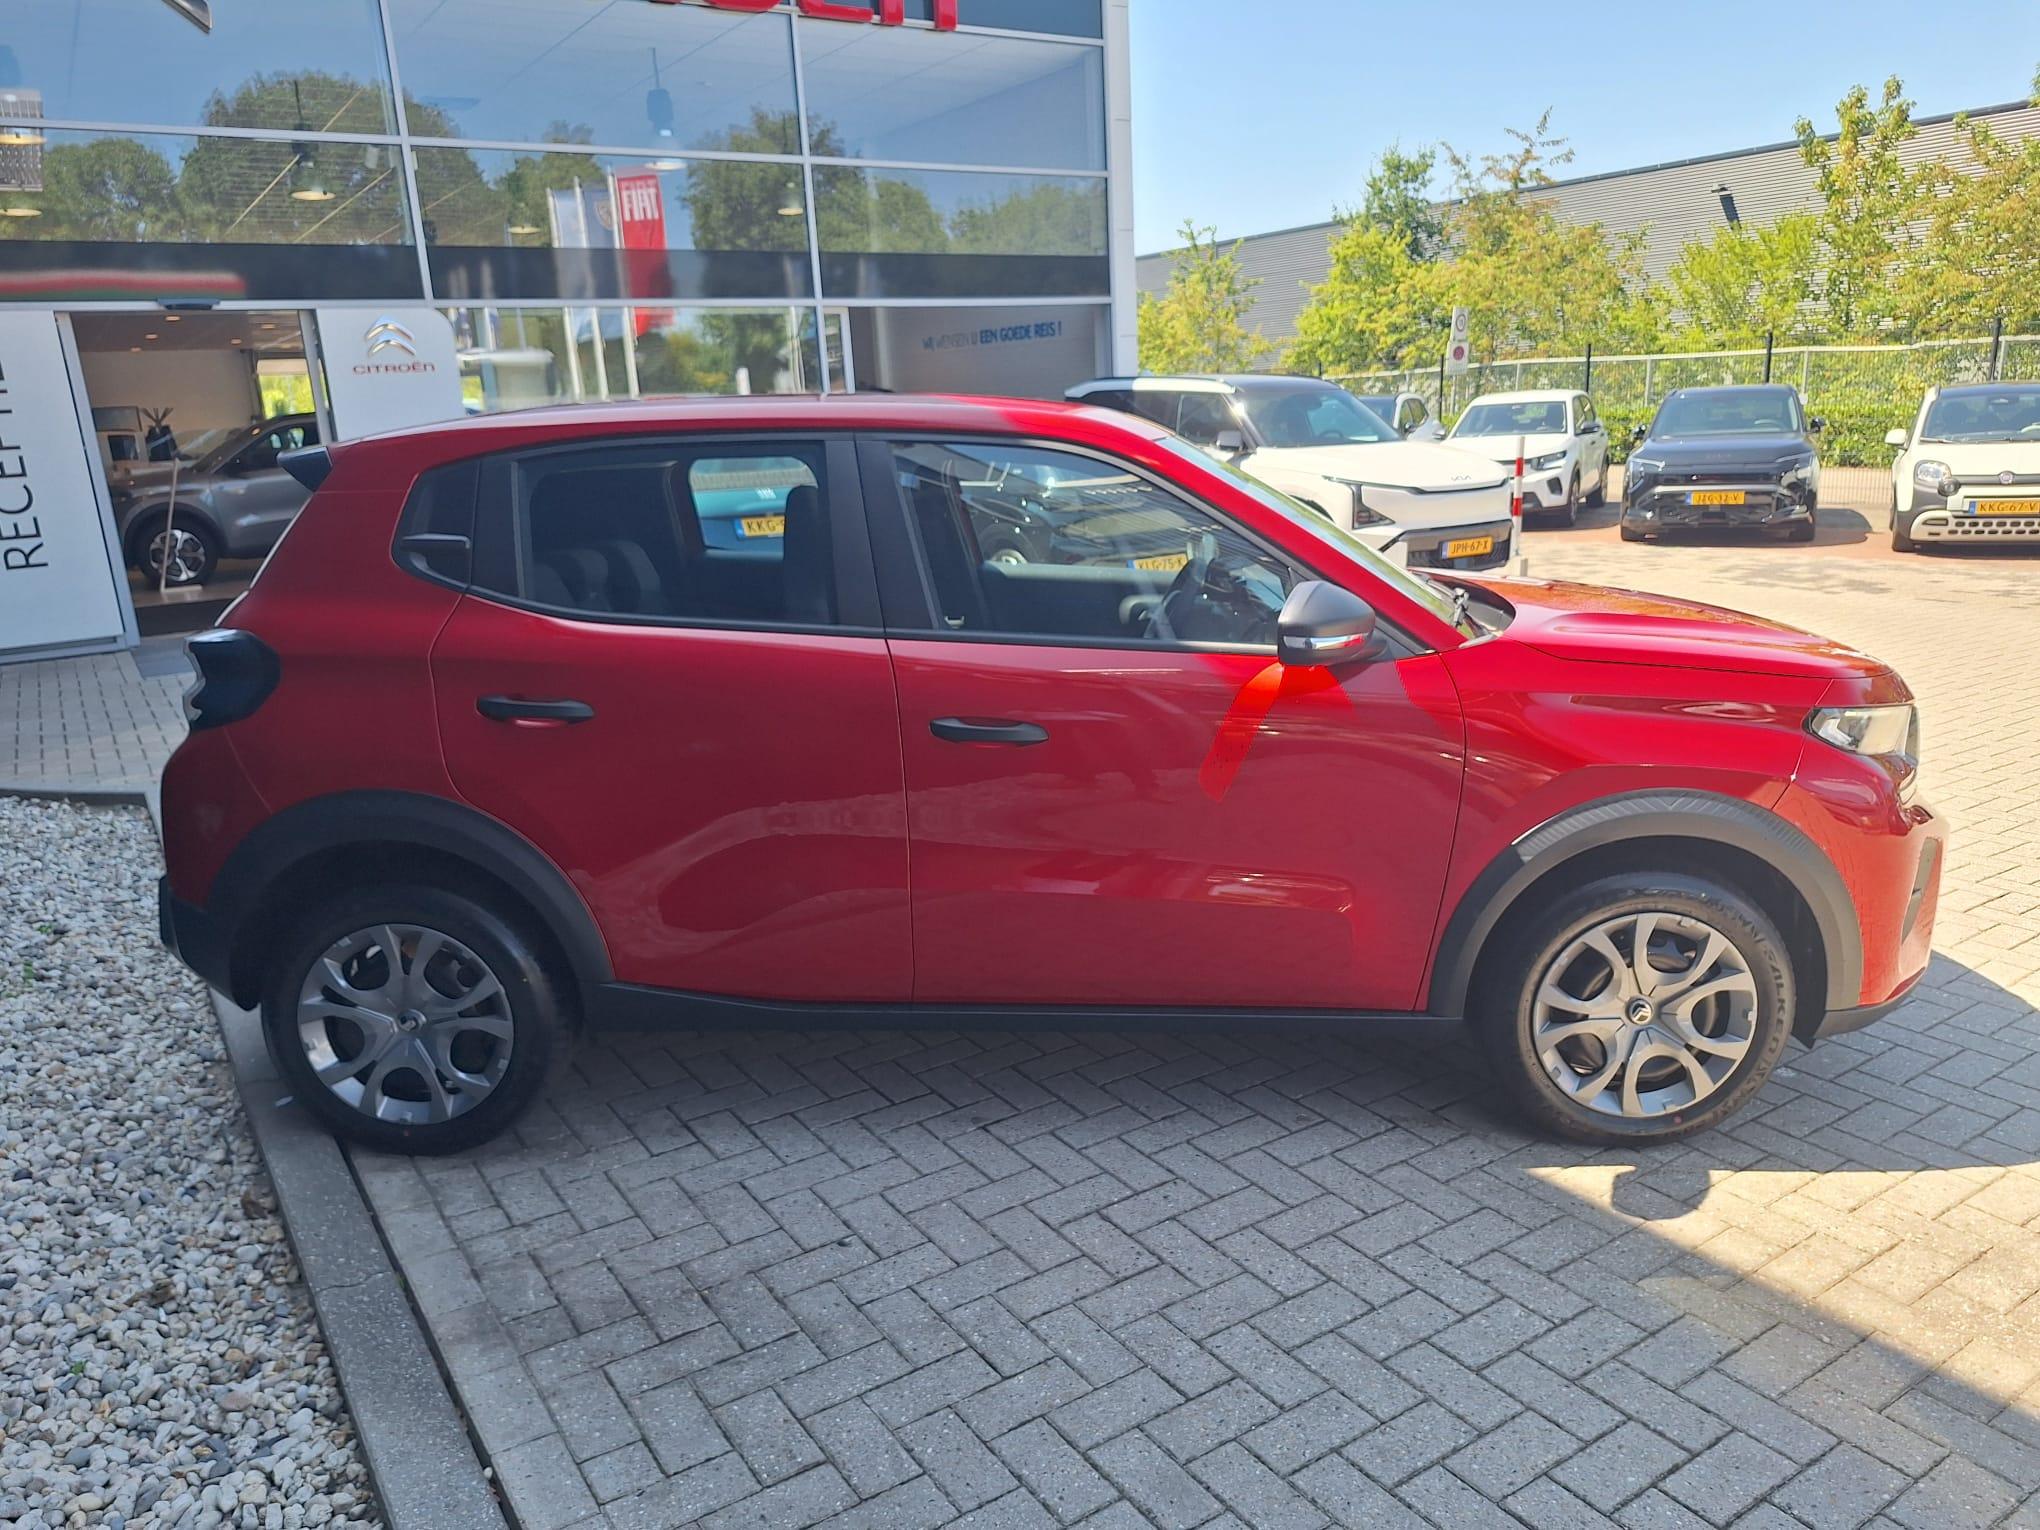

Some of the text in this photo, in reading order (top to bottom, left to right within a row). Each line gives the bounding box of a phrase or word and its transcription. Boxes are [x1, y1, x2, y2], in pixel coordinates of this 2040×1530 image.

[621, 188, 660, 221] FIAT
[979, 328, 998, 344] EEN
[1000, 324, 1031, 341] GOEDE
[1033, 322, 1056, 338] REIS
[1979, 501, 2037, 513] KKG-67-V
[1450, 538, 1490, 555] JPH-67-X
